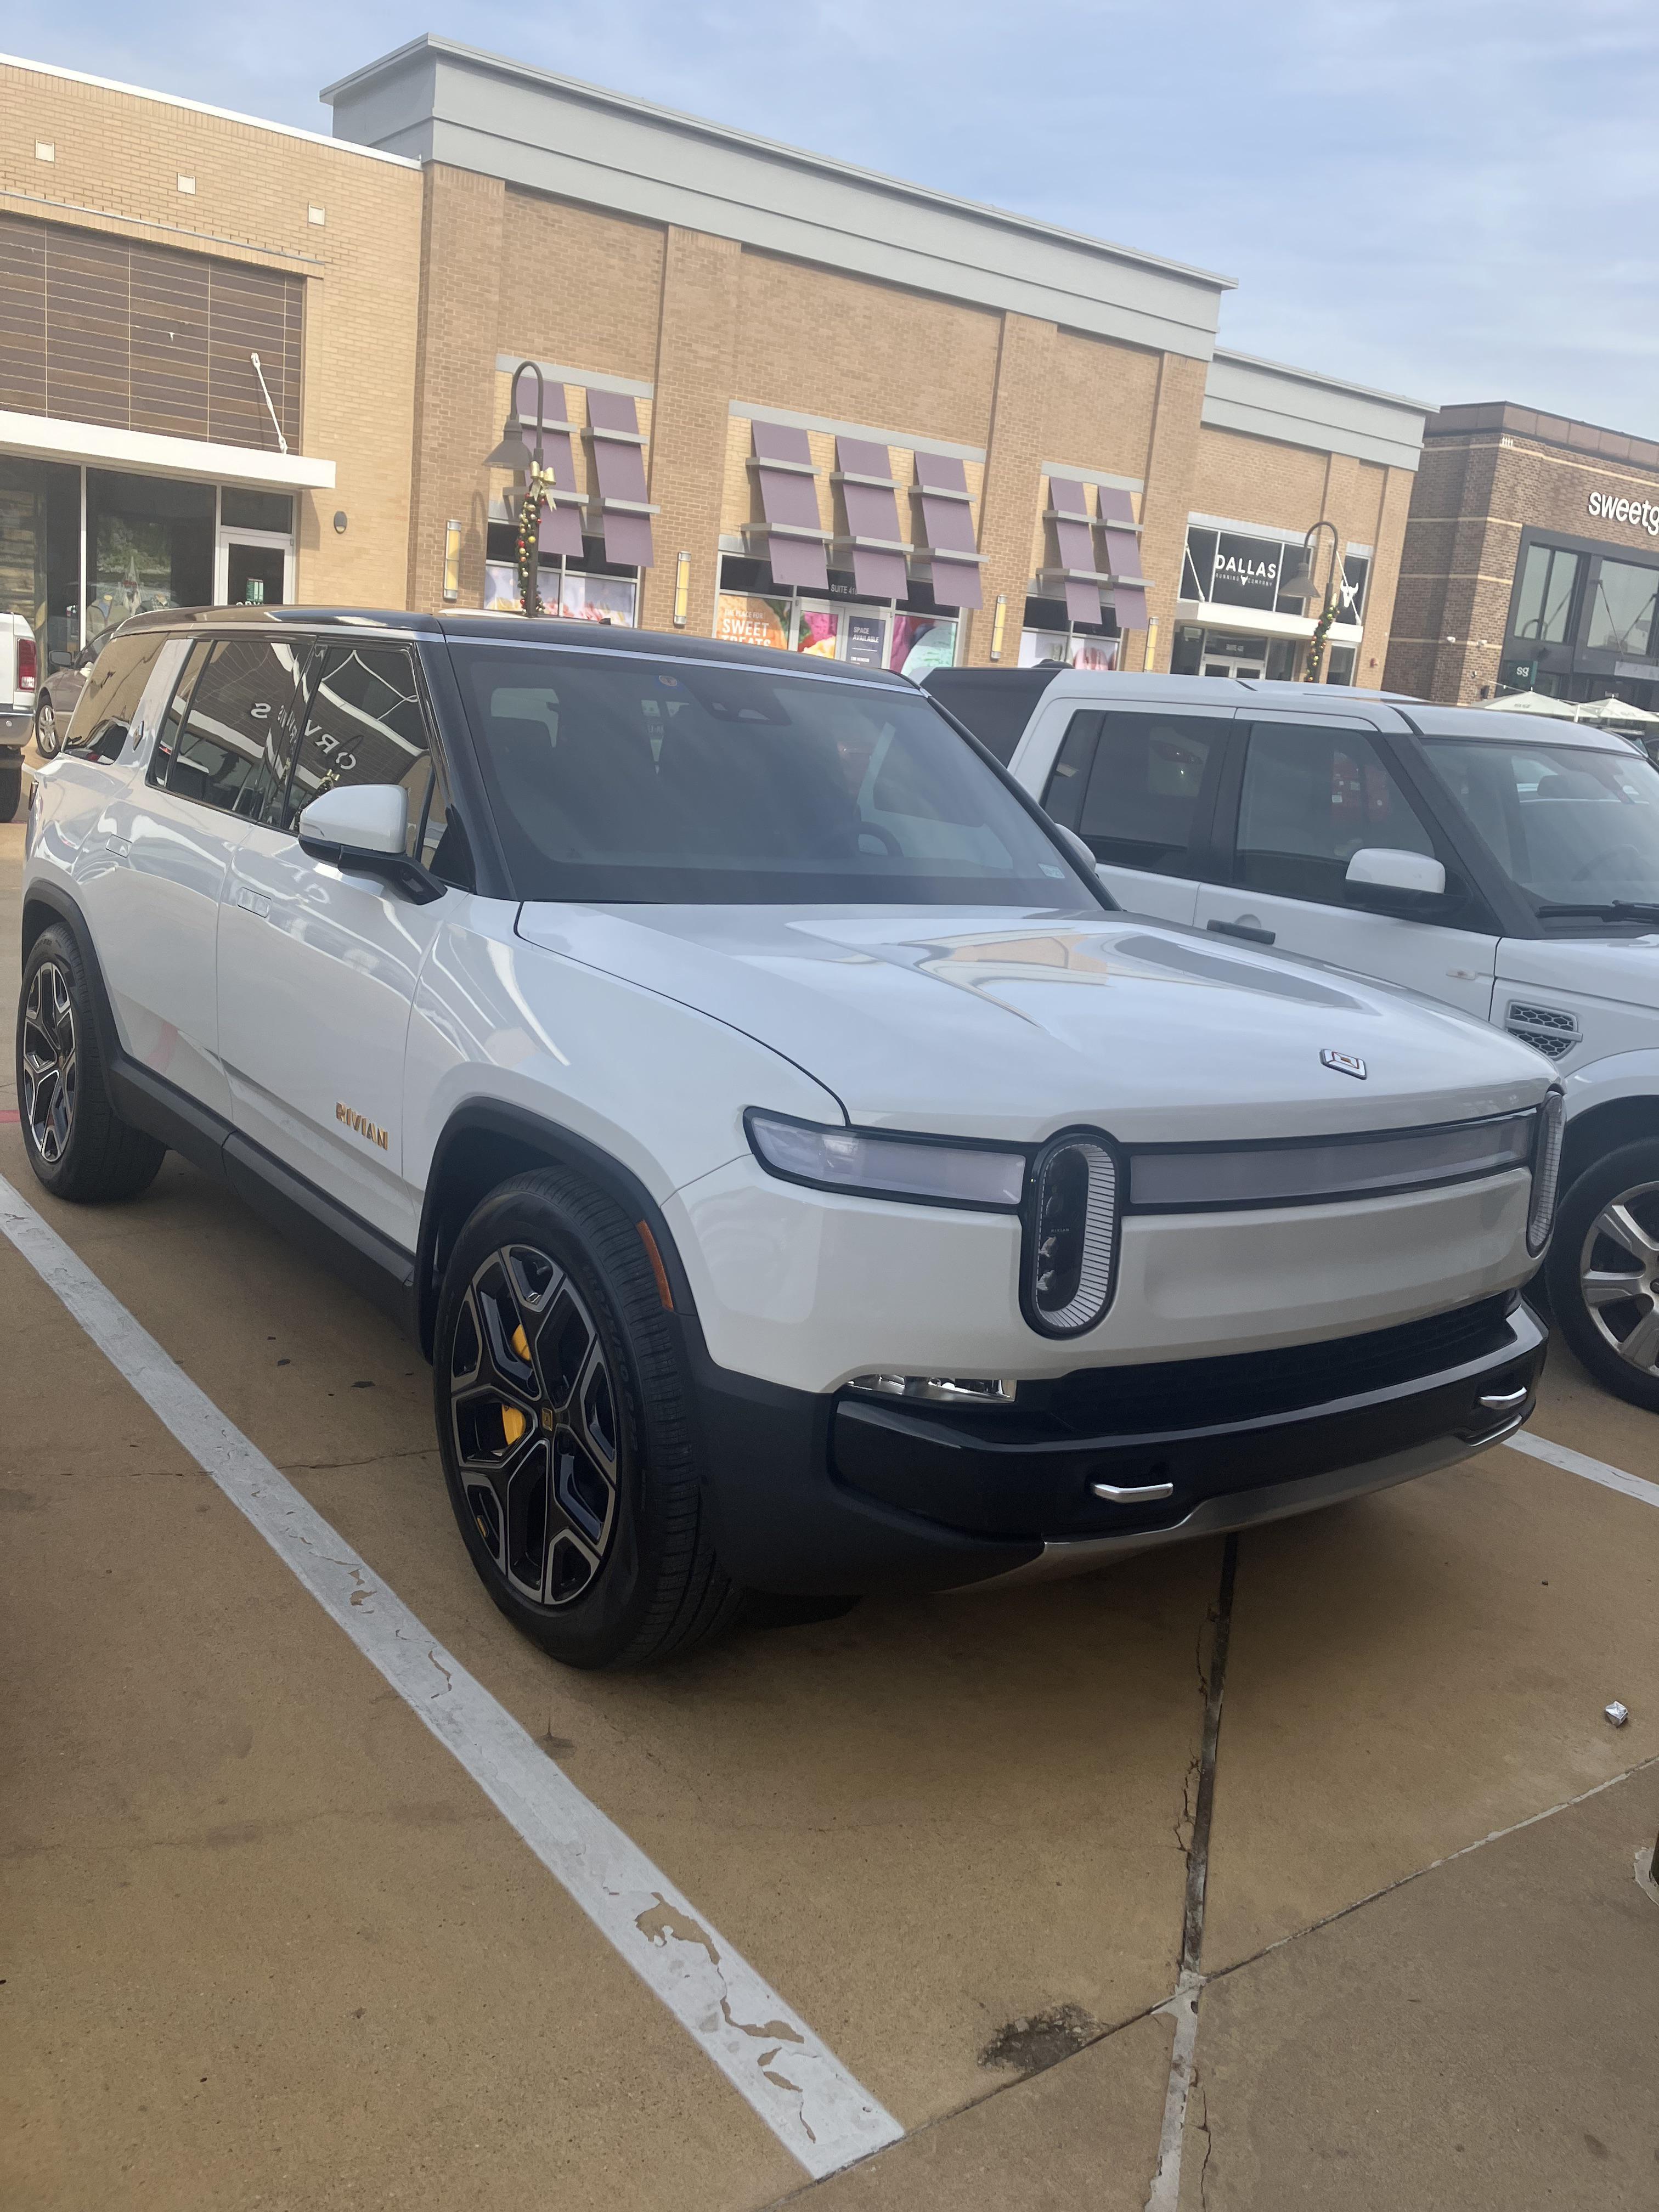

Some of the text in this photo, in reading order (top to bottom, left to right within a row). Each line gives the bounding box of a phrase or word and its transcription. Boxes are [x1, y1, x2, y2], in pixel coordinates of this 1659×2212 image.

[1215, 554, 1277, 579] DALLAS
[831, 584, 848, 594] SUITE
[735, 610, 752, 618] PLACE
[722, 618, 769, 637] SWEET
[852, 634, 879, 643] AVAILABLE
[1516, 667, 1530, 677] sg
[336, 1102, 388, 1151] RIVIAN
